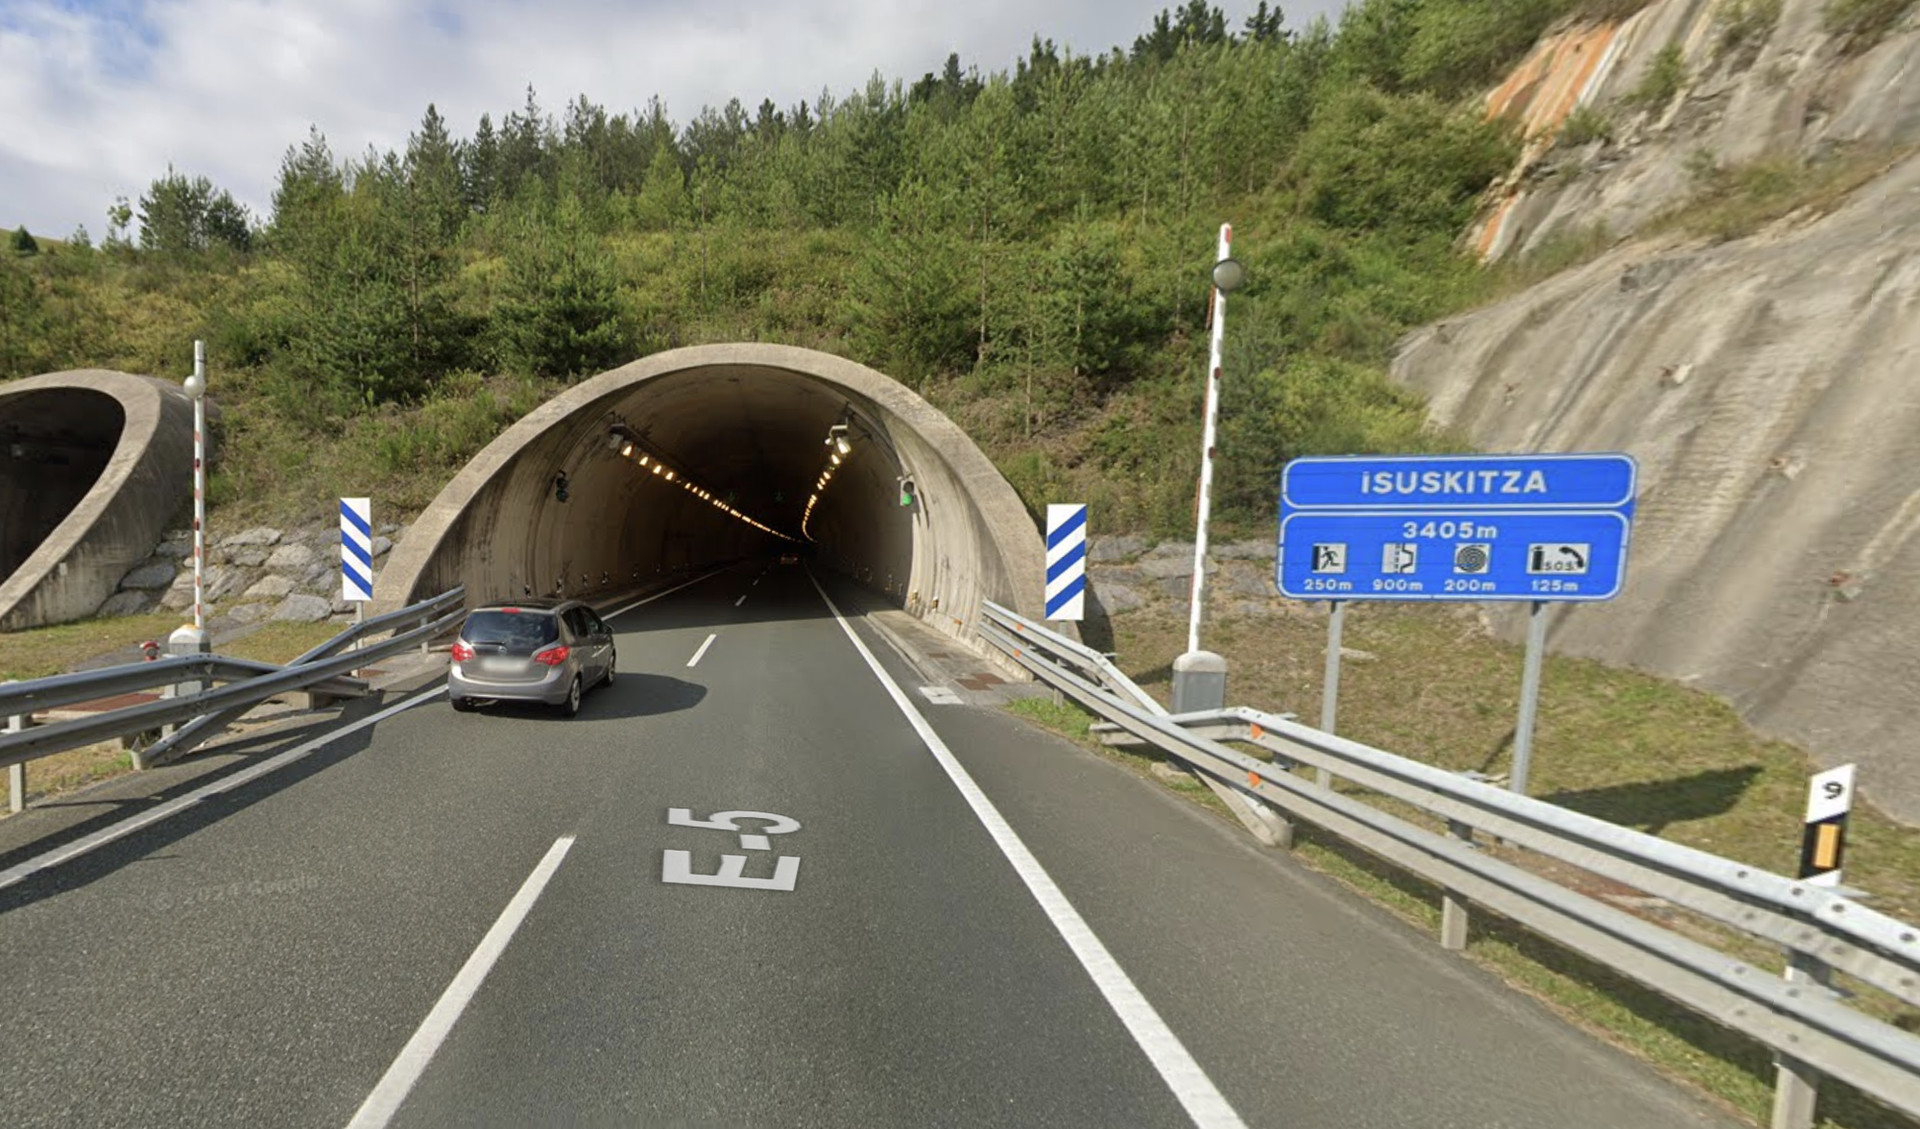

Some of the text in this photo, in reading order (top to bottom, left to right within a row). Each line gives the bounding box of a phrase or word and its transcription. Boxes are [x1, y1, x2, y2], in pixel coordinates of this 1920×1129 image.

[1403, 521, 1497, 539] 3405m
[1304, 578, 1353, 591] 250m
[1373, 578, 1423, 591] 900m
[1444, 579, 1496, 592] 200m
[1531, 579, 1579, 592] 125m
[1823, 781, 1844, 800] 9
[662, 807, 802, 892] E-5
